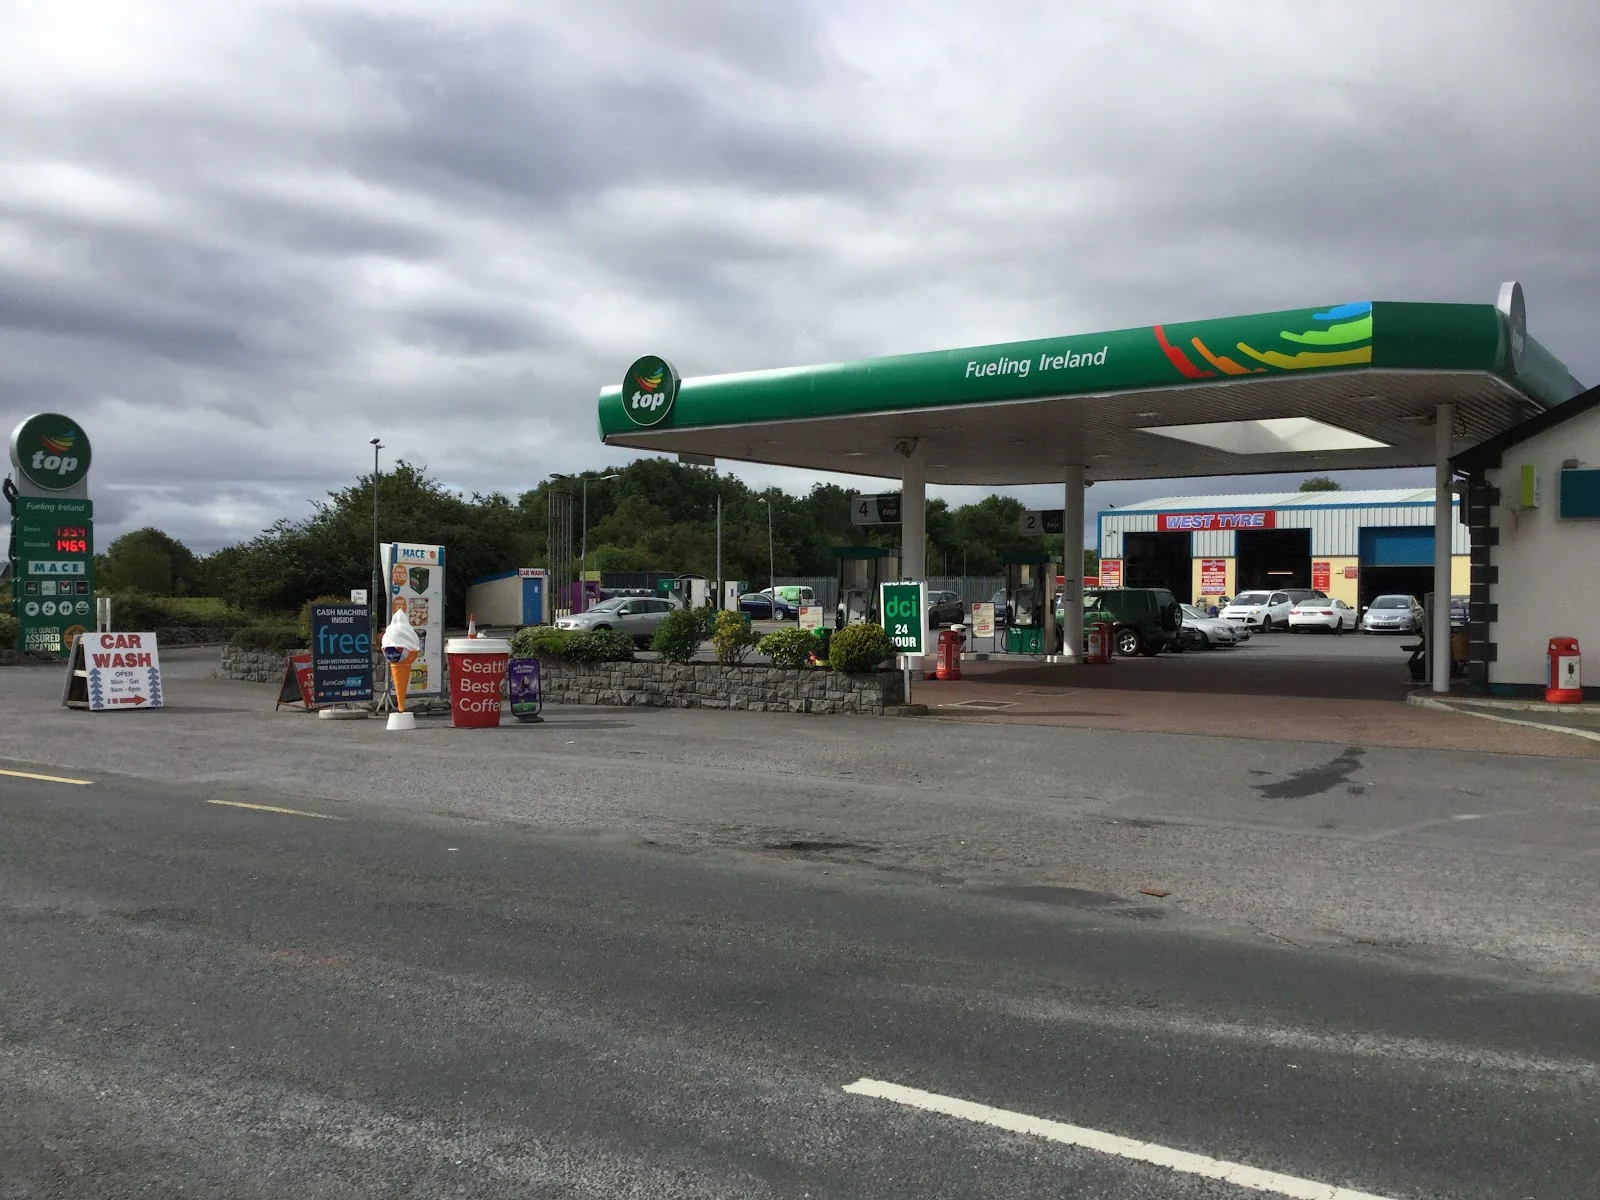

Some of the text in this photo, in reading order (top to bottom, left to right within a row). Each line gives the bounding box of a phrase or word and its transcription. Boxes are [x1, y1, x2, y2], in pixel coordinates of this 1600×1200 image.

[965, 345, 1108, 378] Fueling Ireland
[631, 390, 665, 411] top
[32, 450, 78, 475] top
[26, 502, 85, 512] Fueling Ireland
[858, 501, 869, 516] 4
[882, 508, 897, 516] top
[1027, 515, 1036, 529] 2
[1165, 513, 1266, 529] WEST TYRE
[402, 548, 426, 558] MACE
[34, 563, 79, 573] MACE
[336, 608, 368, 616] MACHINE
[886, 594, 917, 617] dci
[331, 616, 354, 624] INSIDE
[38, 626, 60, 634] QUALITY
[894, 623, 909, 635] 24
[25, 633, 60, 643] ASSURED
[100, 634, 142, 649] CAR
[317, 624, 370, 654] free
[889, 636, 917, 648] OUR
[92, 652, 152, 668] WASH
[322, 679, 346, 687] EuroCash
[460, 678, 496, 693] Best
